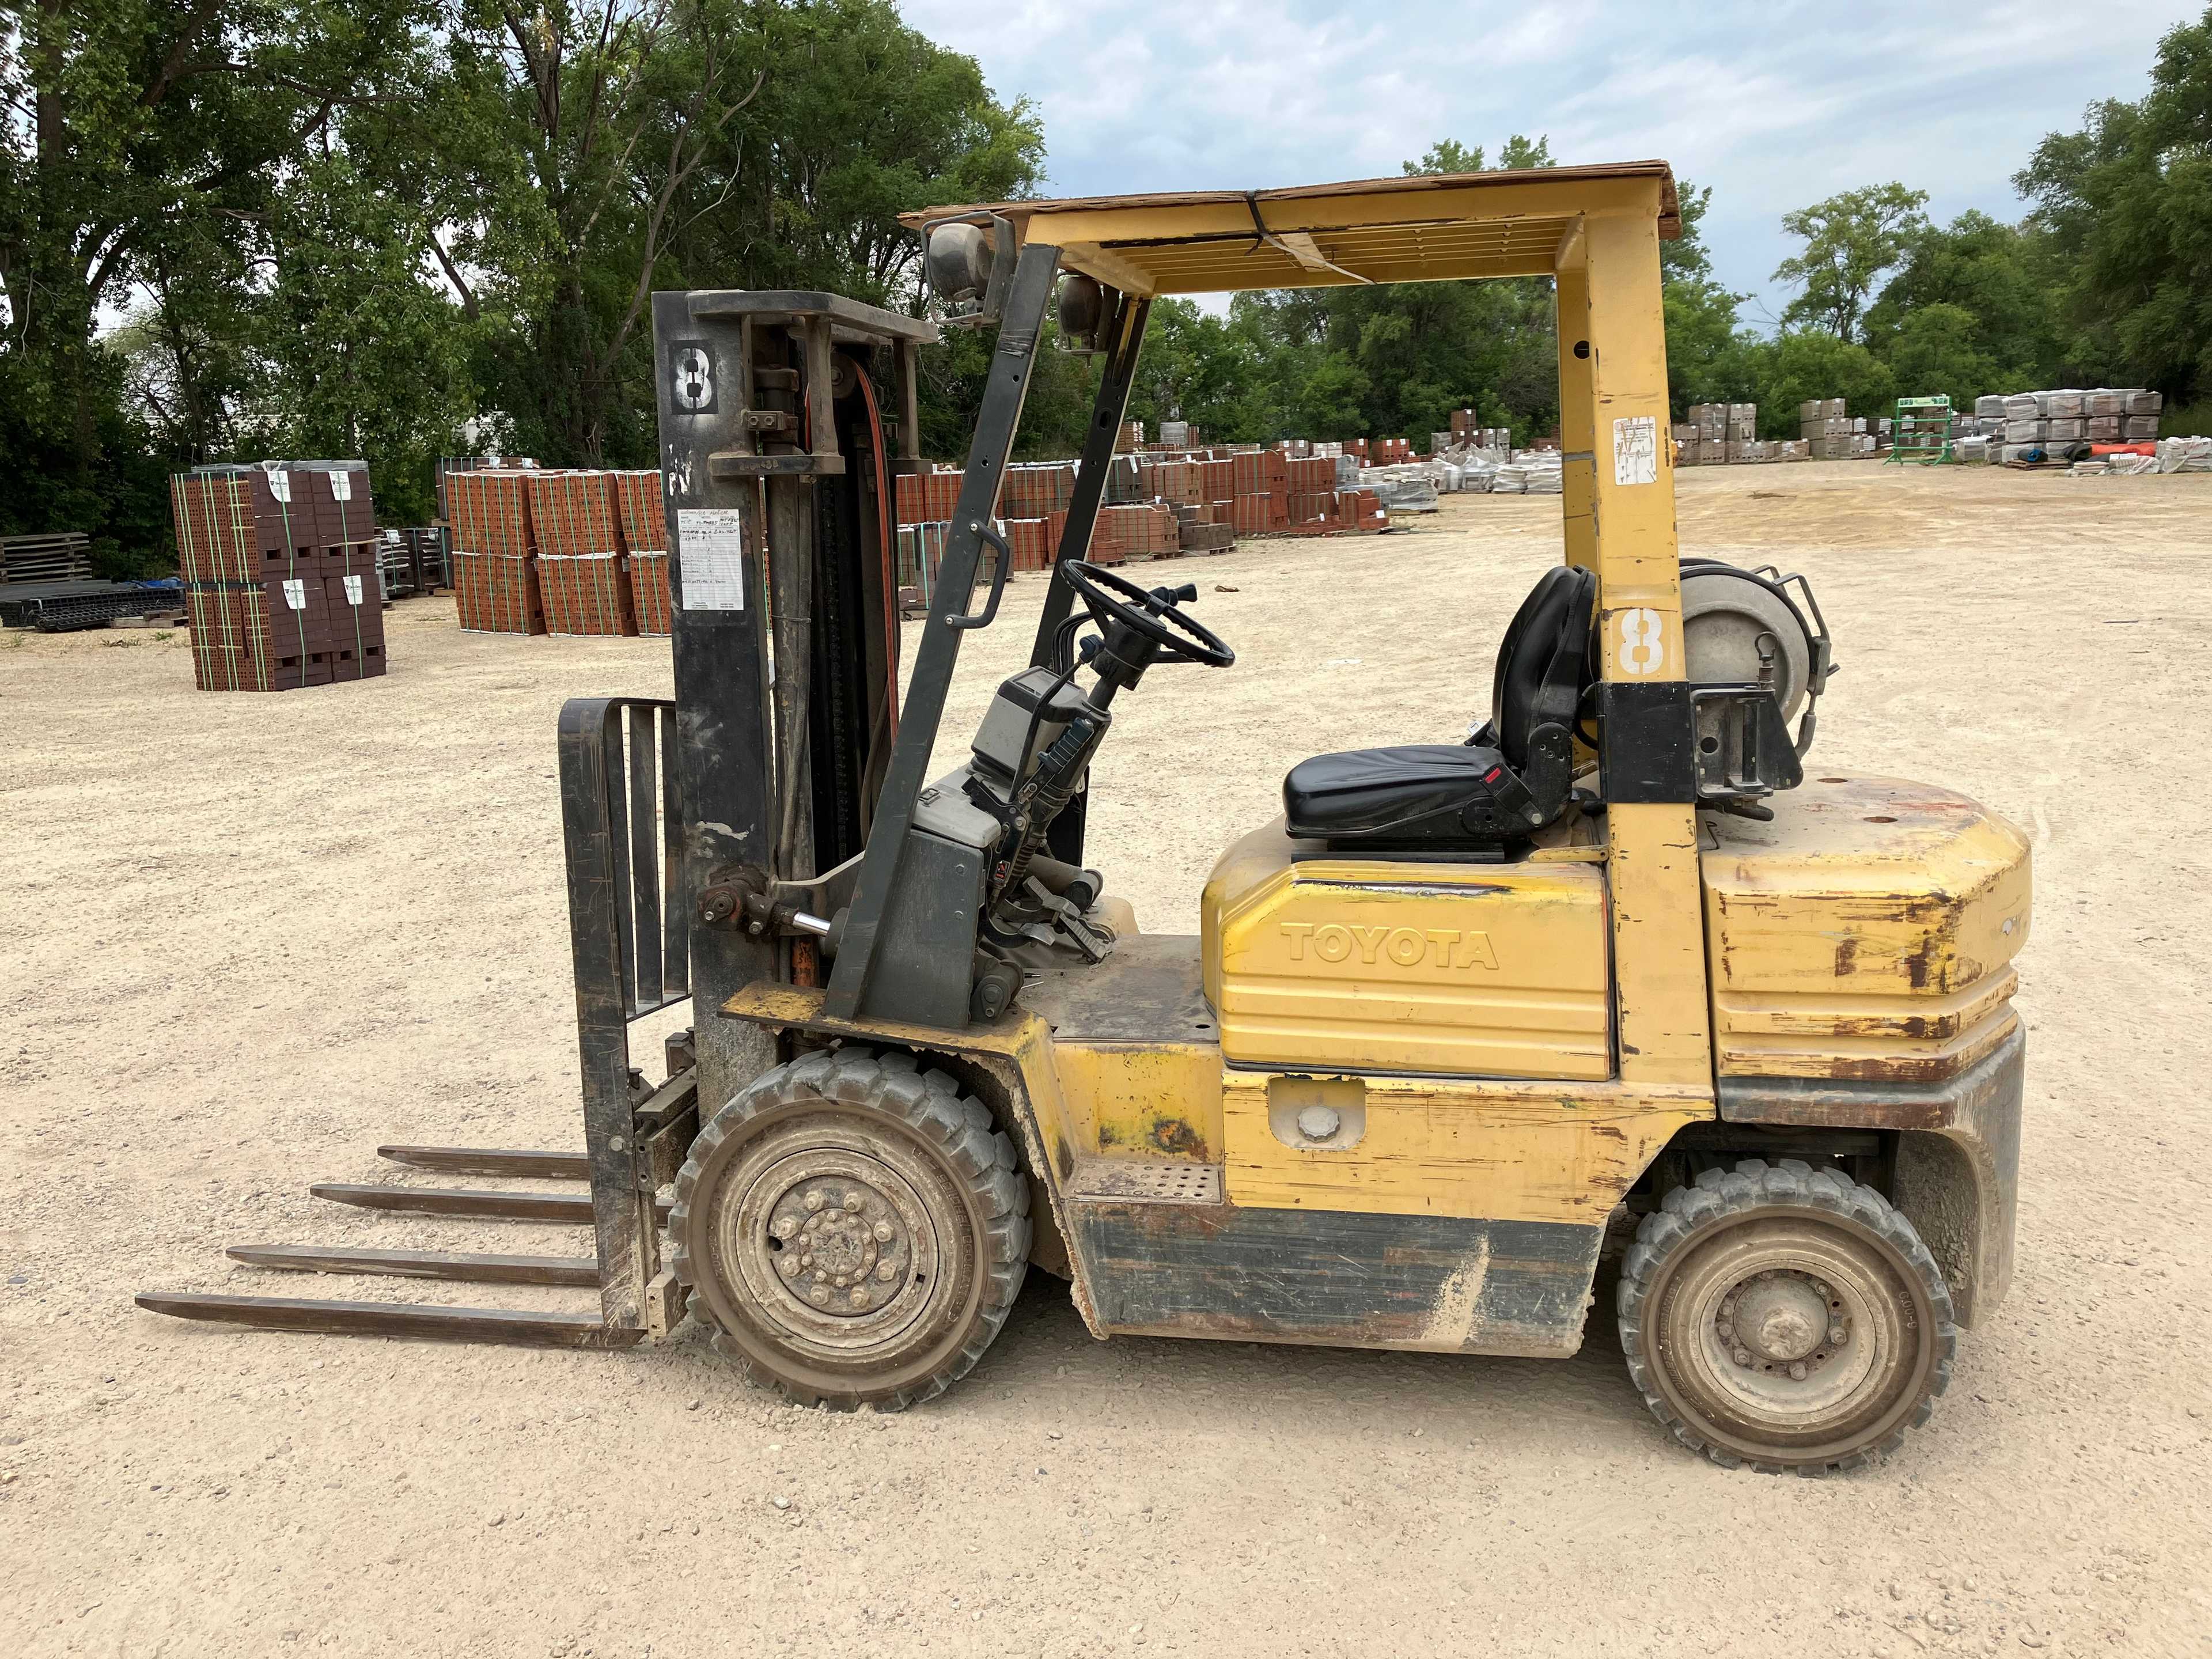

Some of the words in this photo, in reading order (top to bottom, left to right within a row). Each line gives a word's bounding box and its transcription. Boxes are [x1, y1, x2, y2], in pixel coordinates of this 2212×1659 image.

[675, 347, 713, 410] 8
[1619, 608, 1663, 674] 8
[1280, 922, 1499, 970] TOYOTA
